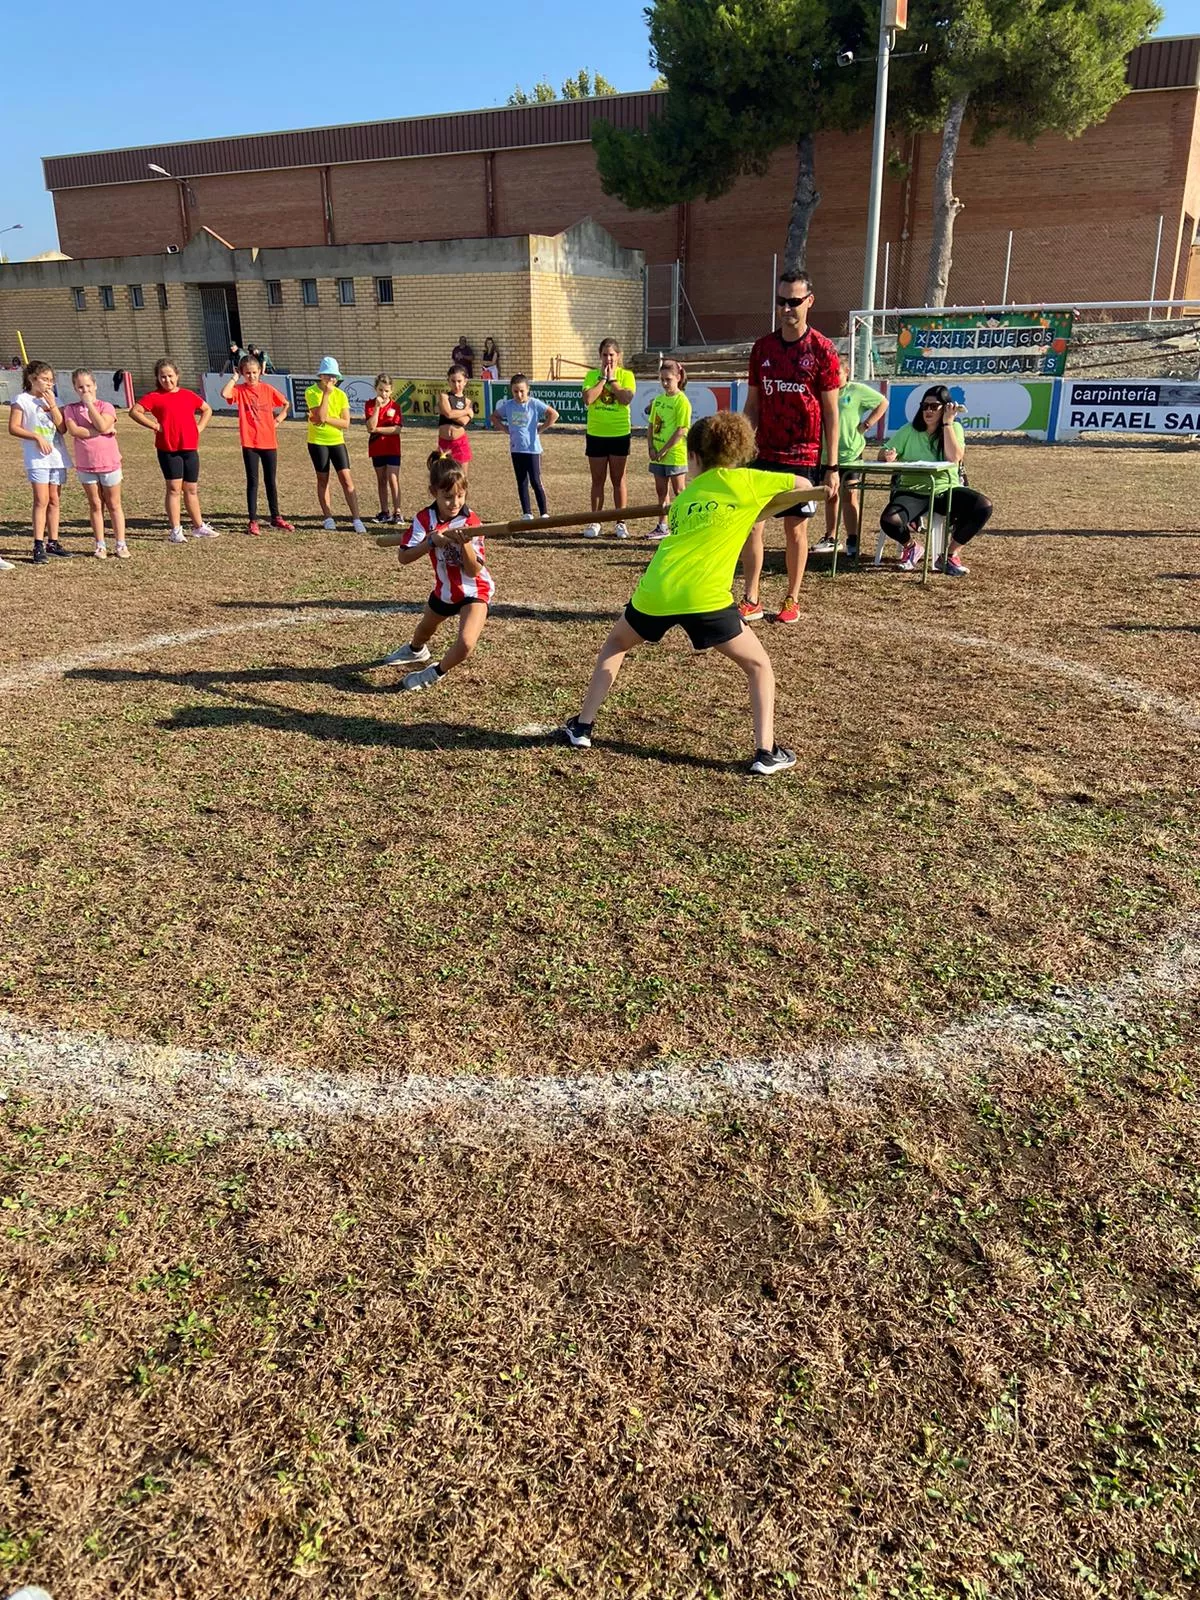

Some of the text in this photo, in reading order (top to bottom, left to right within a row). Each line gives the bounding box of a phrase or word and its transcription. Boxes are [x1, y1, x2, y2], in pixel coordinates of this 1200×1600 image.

[917, 332, 1053, 345] XXXIX JUEGOS
[905, 358, 1056, 370] TRADICIONALES
[774, 380, 806, 392] Tezos
[1073, 387, 1156, 403] carpintería
[1070, 411, 1156, 429] RAFAEL
